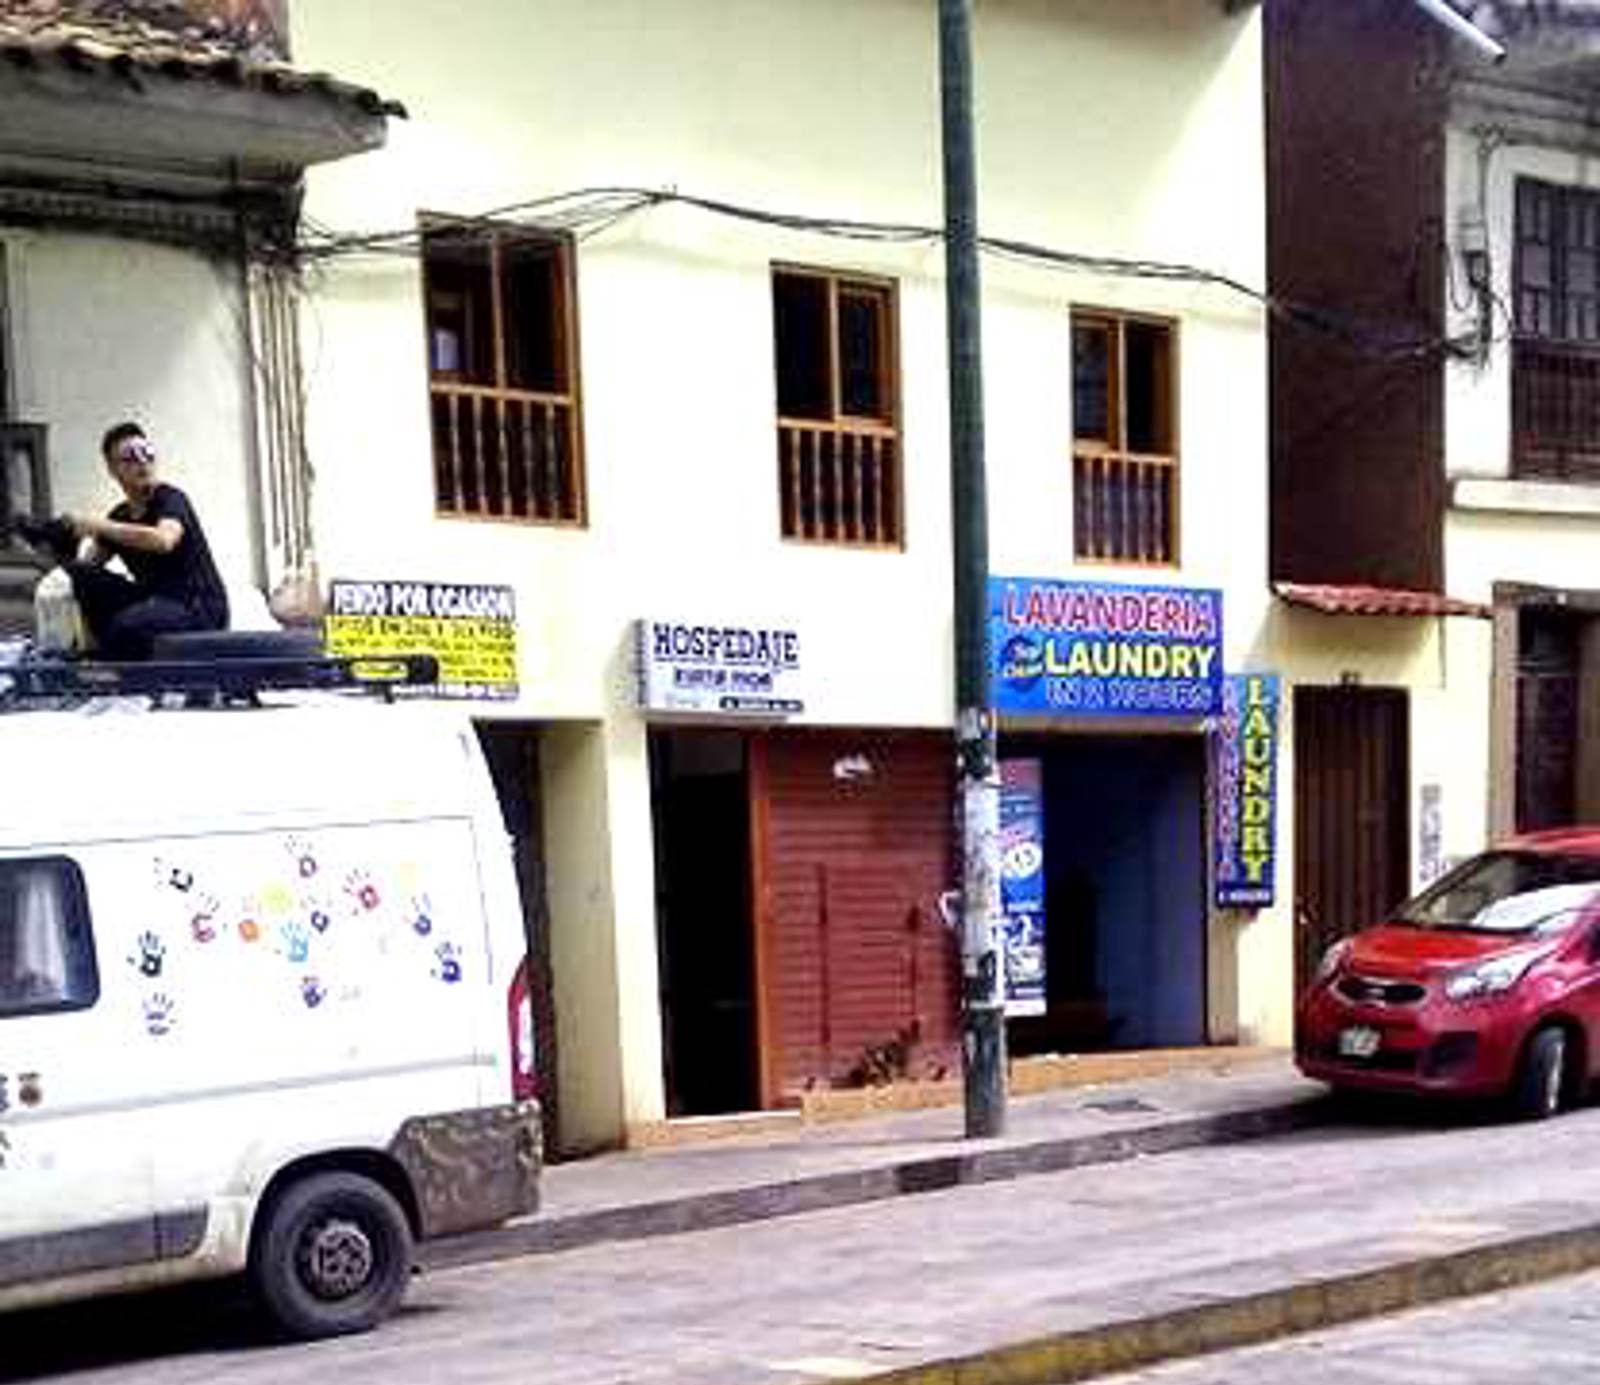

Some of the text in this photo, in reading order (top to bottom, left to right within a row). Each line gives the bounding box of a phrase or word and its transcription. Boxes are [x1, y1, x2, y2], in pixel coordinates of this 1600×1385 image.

[1003, 583, 1216, 639] LAVANDERIA
[653, 622, 799, 667] HOSPEDAJE
[1044, 638, 1216, 677] LAUNDRY
[1243, 677, 1271, 882] LAUNDRY
